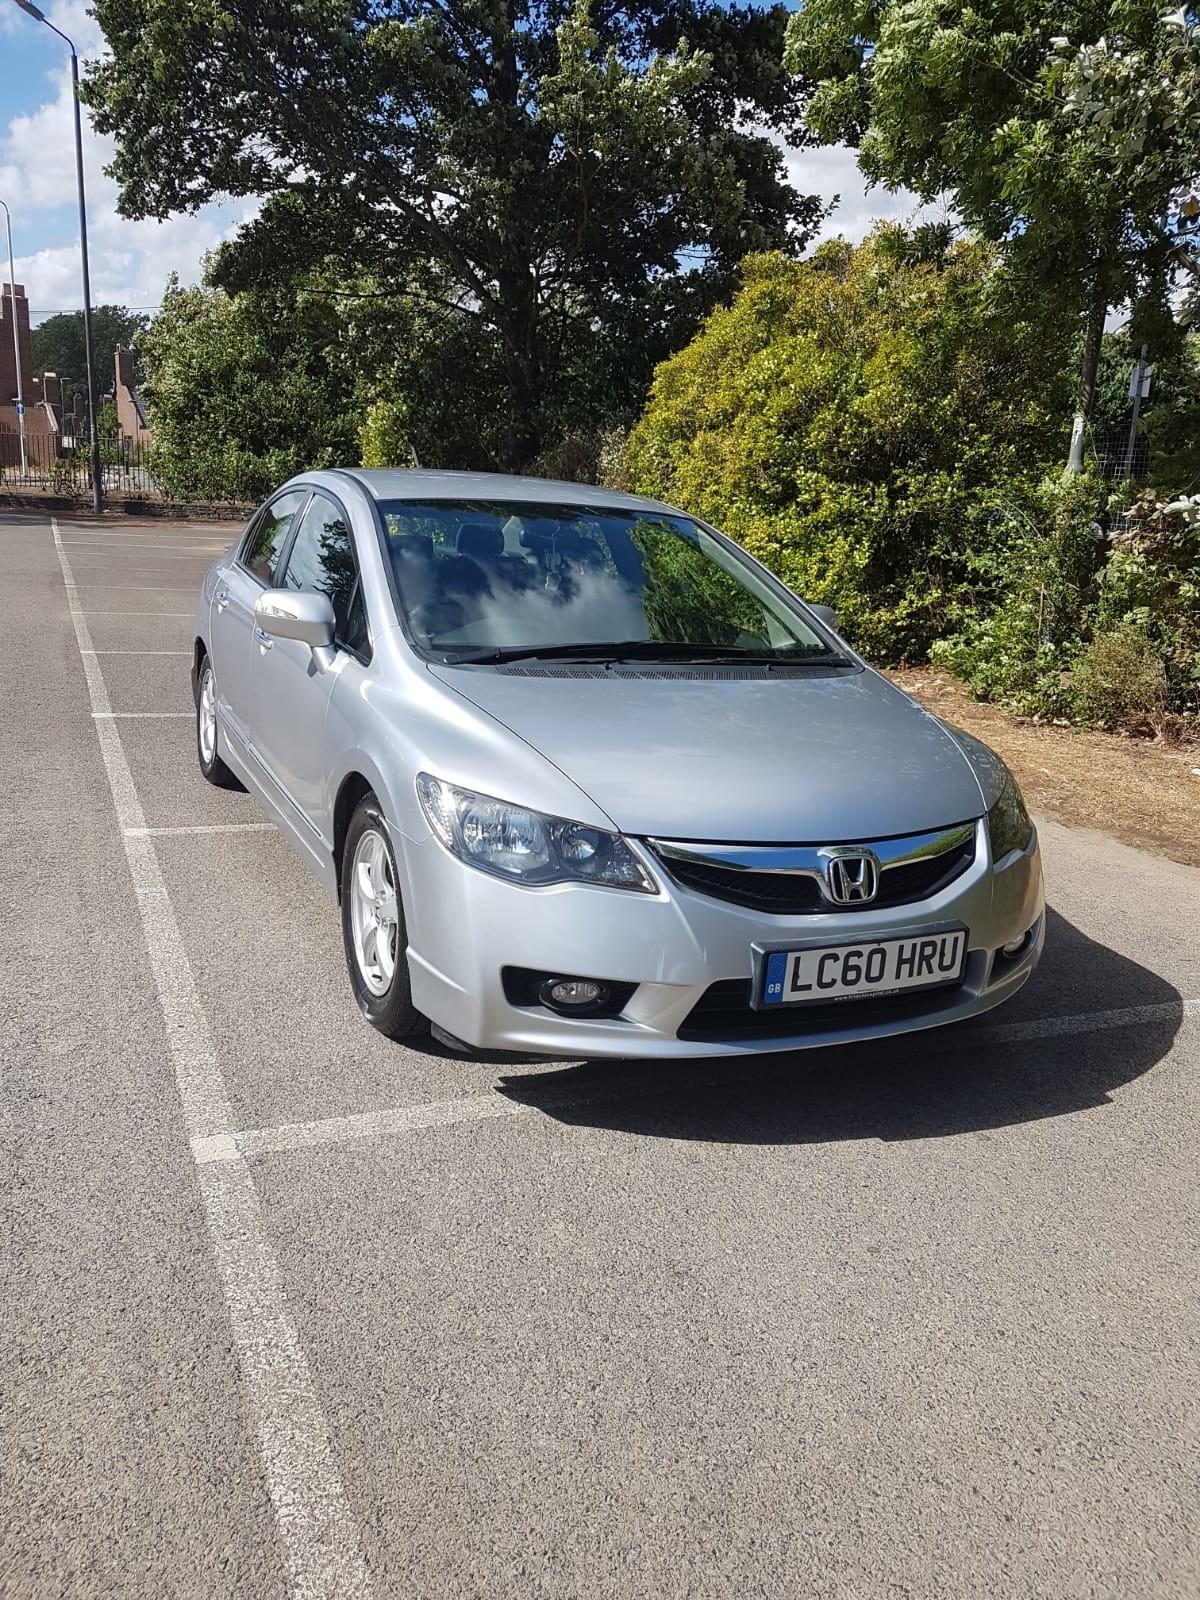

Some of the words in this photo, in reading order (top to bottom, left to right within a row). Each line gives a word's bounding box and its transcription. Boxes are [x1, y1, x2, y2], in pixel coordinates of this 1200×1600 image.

[790, 946, 887, 993] LC60
[894, 936, 960, 980] HRU
[767, 983, 781, 994] GB
